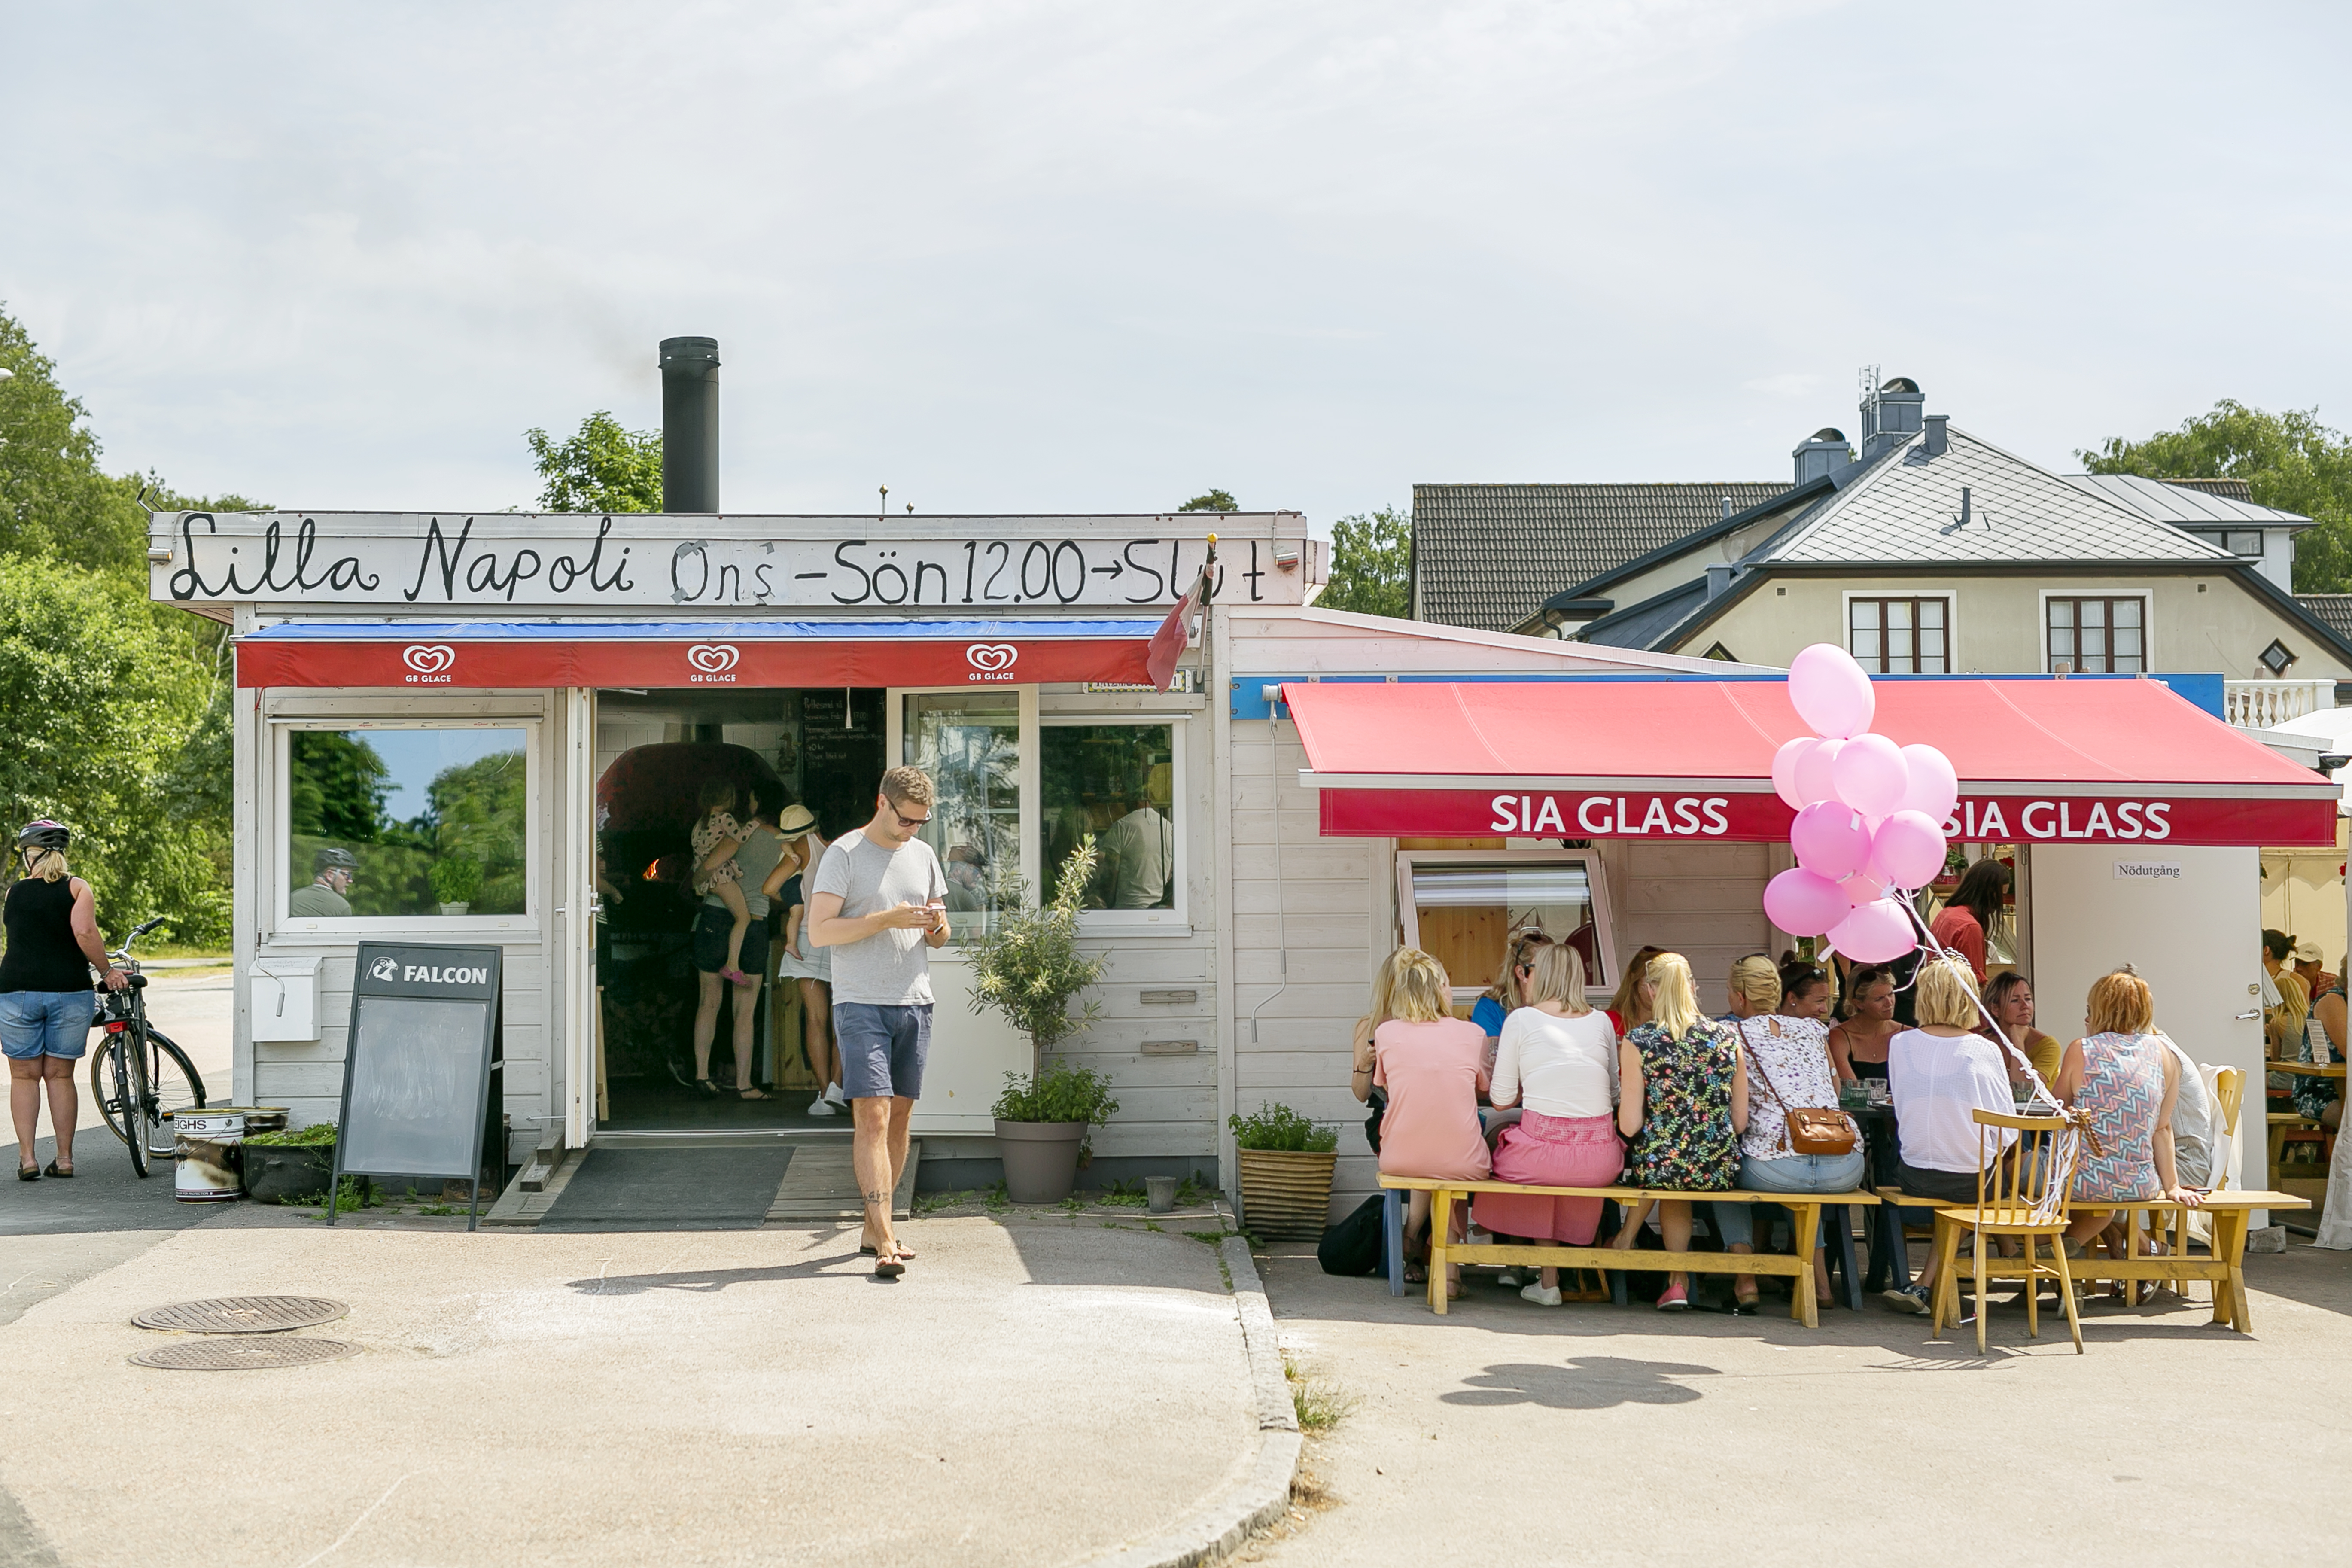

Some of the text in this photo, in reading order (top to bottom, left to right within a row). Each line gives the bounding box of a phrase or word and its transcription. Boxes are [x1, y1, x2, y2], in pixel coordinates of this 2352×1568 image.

[171, 514, 379, 600] Lilla
[404, 516, 634, 601] Napoli
[671, 542, 773, 601] Ons
[961, 540, 1086, 603] 12.00
[969, 673, 1014, 681] GB GLACE
[1491, 795, 1728, 835] SIA GLASS
[2021, 801, 2171, 839] GLASS
[2119, 865, 2180, 879] Nödutgång
[404, 965, 488, 984] FALCON
